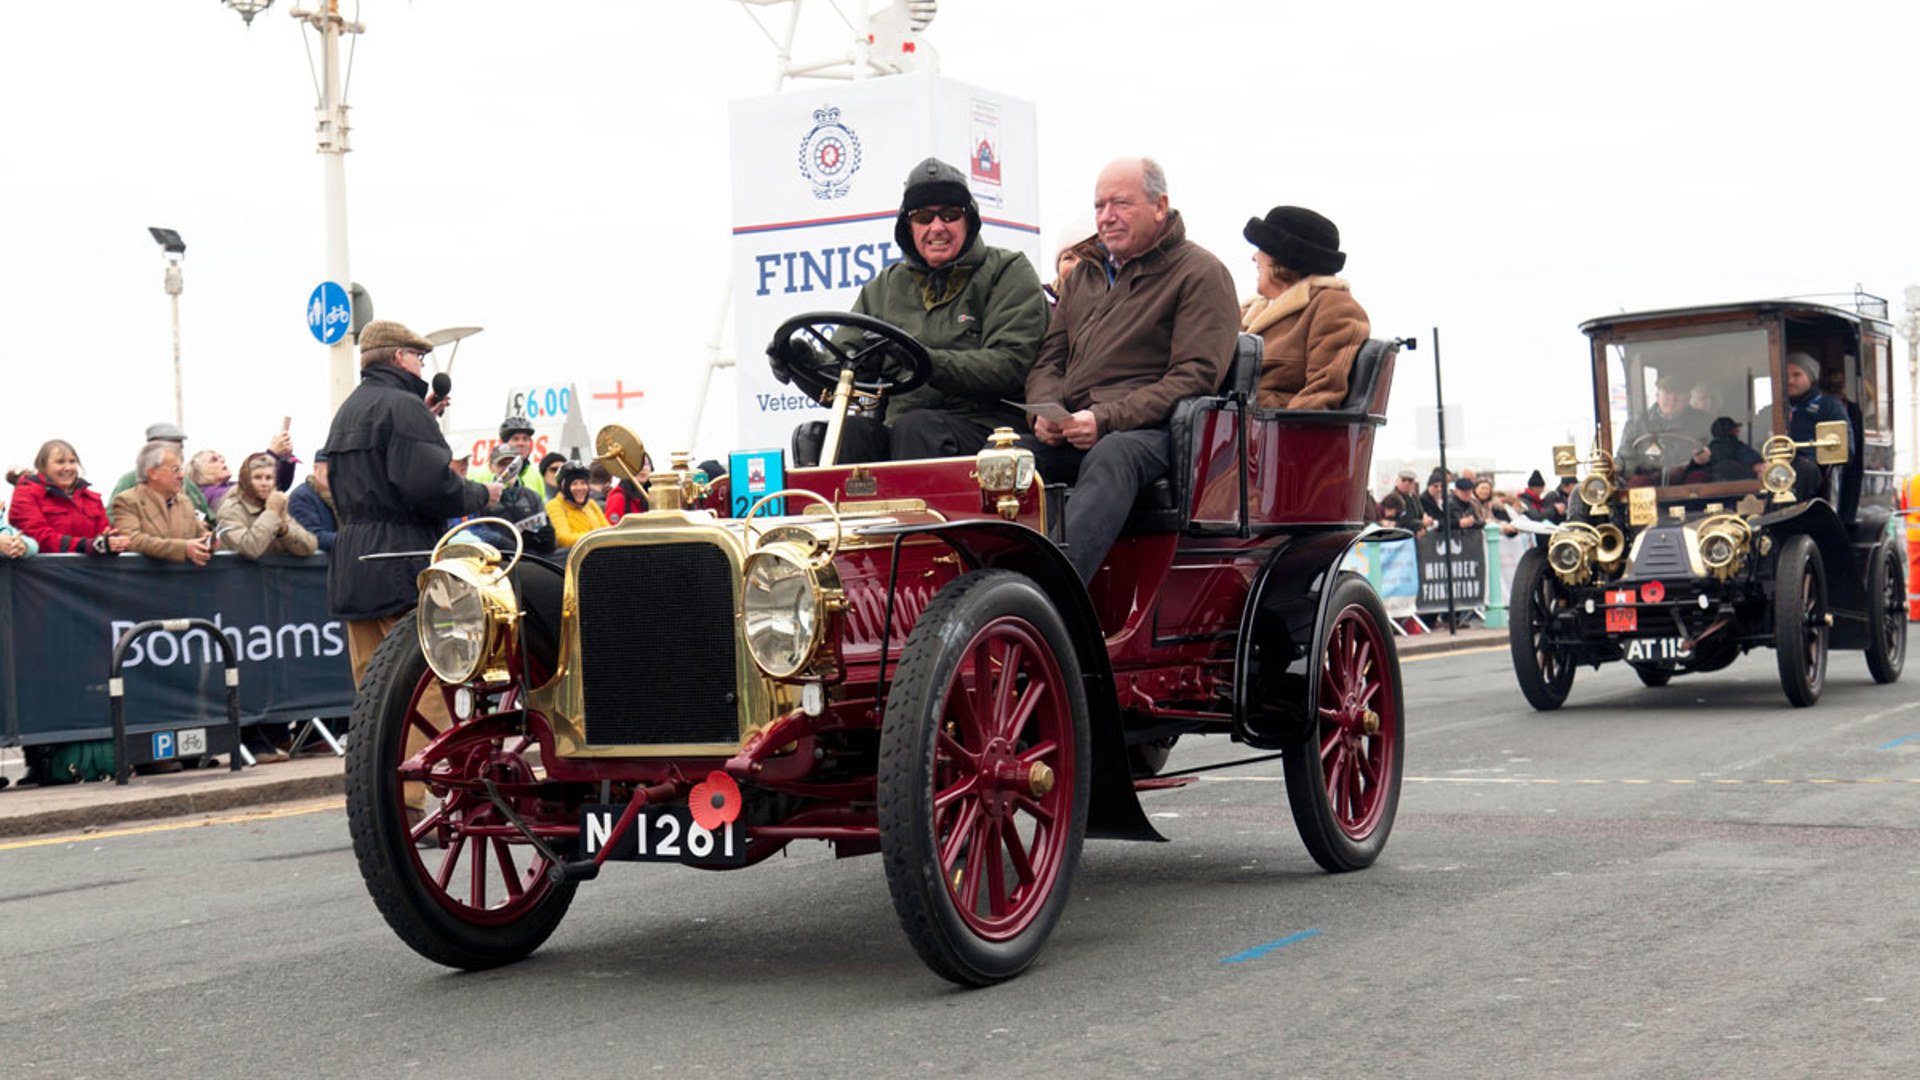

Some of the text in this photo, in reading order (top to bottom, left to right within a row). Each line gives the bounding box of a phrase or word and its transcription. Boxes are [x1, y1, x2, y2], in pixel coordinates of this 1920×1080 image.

[514, 387, 570, 418] £6.00
[735, 495, 782, 519] 250
[1610, 609, 1635, 623] 179
[111, 613, 344, 667] Bonhams
[1627, 637, 1692, 660] AT 115
[157, 734, 171, 757] P
[586, 812, 735, 858] N 1261
